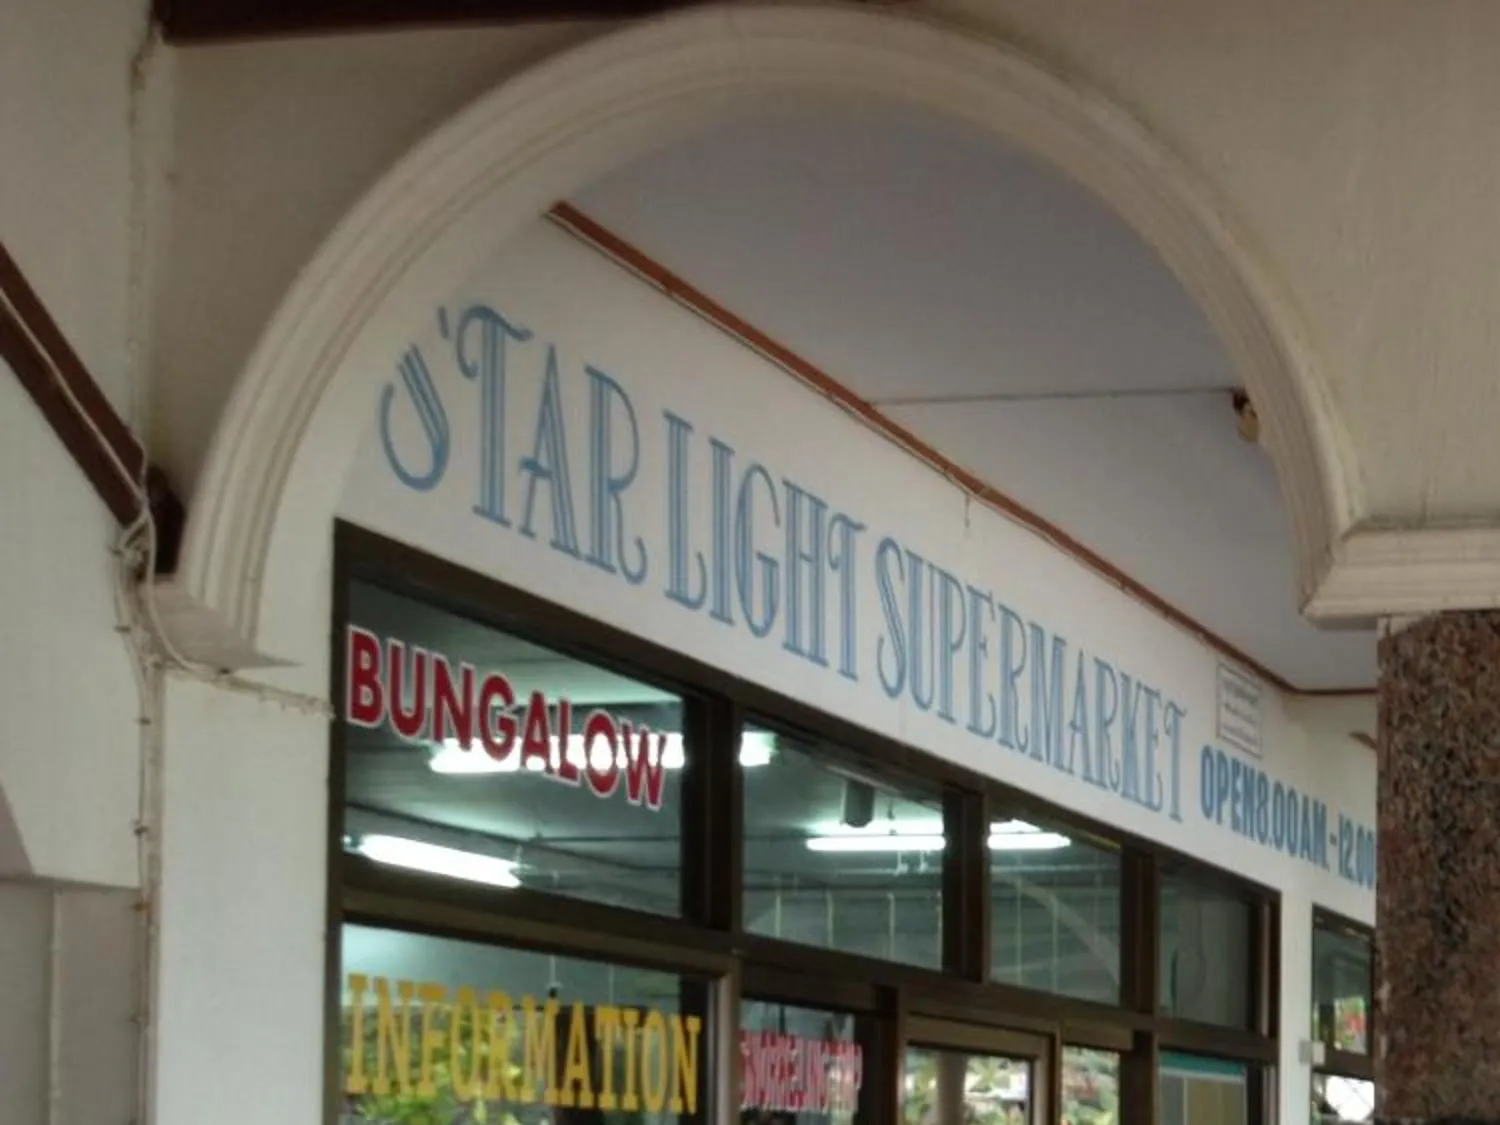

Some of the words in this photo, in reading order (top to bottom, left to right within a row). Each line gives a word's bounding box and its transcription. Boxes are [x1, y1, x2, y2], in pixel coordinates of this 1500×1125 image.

[378, 303, 649, 586] STAR
[662, 409, 868, 682] LIGHT
[875, 537, 1188, 824] SUPERMARKET
[347, 624, 667, 811] BUNGALOW
[345, 972, 702, 1115] INFORMATION
